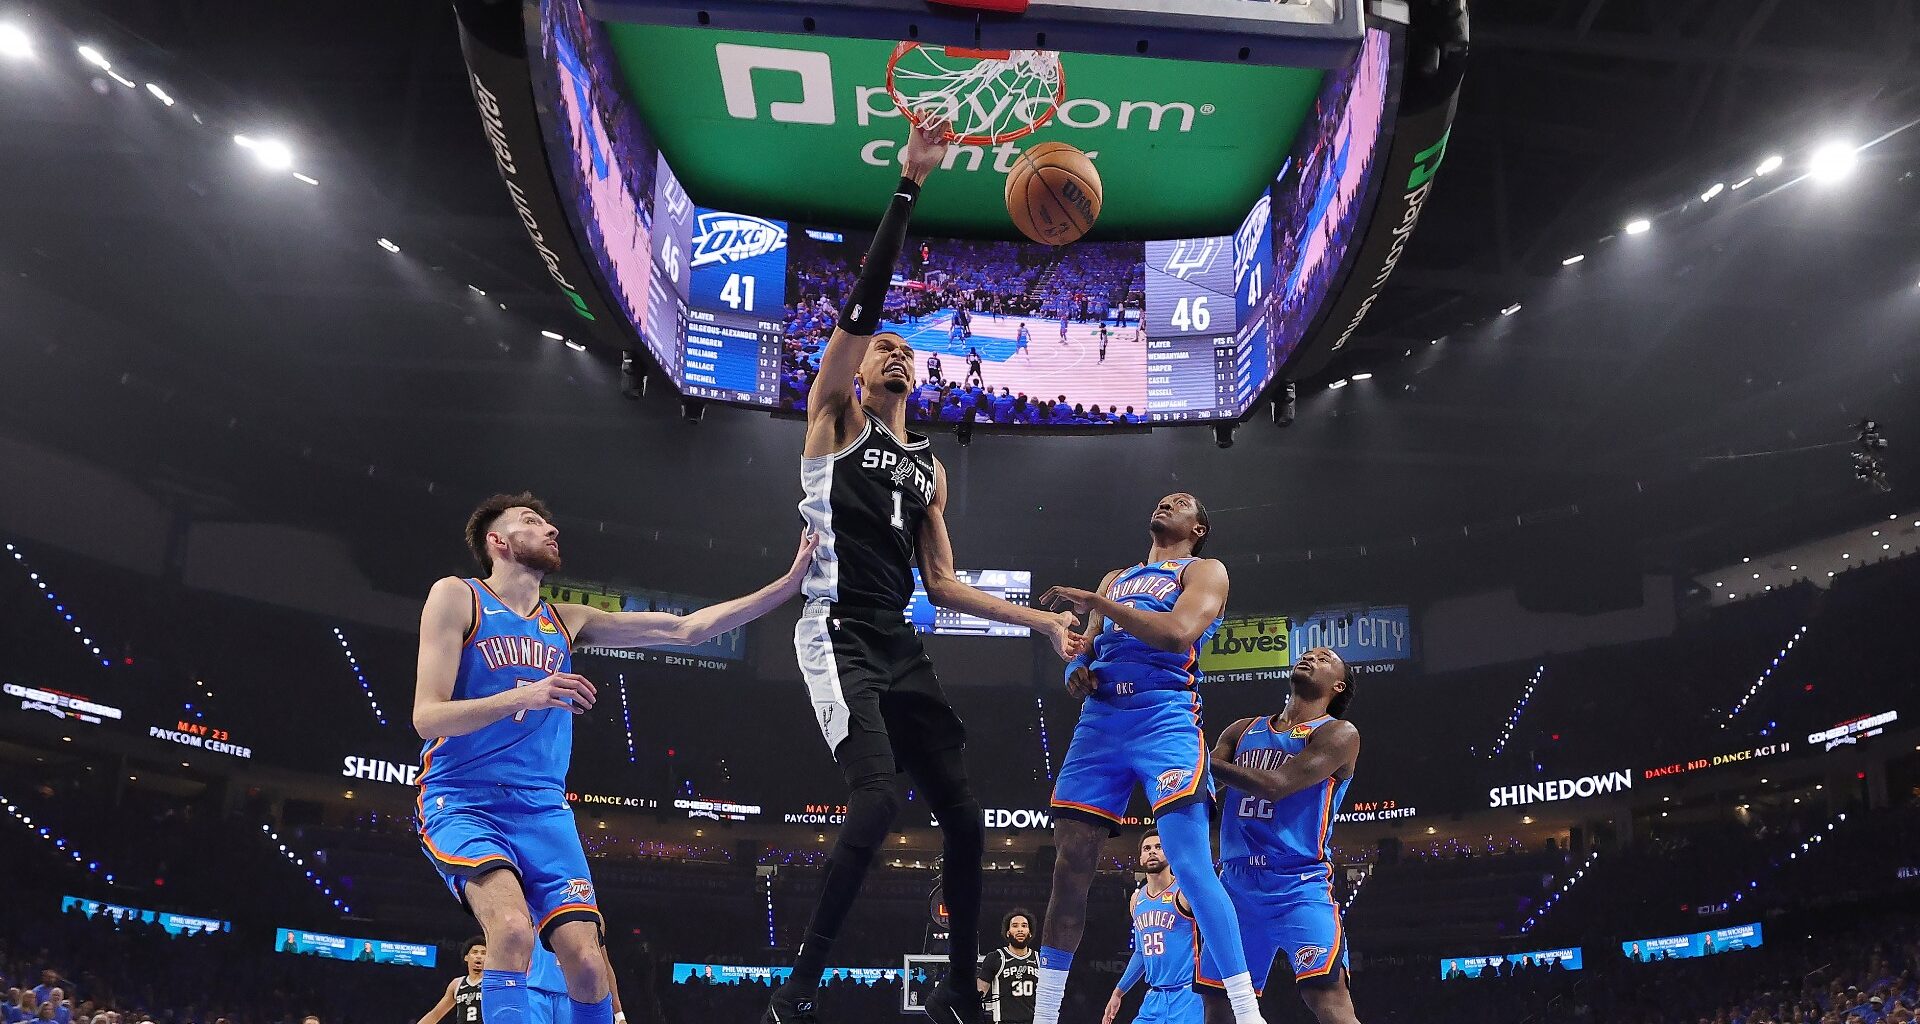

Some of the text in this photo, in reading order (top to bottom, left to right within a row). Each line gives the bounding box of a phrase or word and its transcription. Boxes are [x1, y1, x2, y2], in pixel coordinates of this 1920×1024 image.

[474, 73, 575, 290] paycom center
[1372, 181, 1430, 289] paycom
[661, 233, 680, 284] 46
[719, 272, 755, 312] 41
[1247, 261, 1262, 307] 41
[690, 310, 780, 331] PLAYER PTS FL
[1170, 296, 1211, 332] 46
[688, 322, 758, 340] GILGEOUS-ALEXANDER
[687, 335, 723, 348] HOLMGREN
[1148, 336, 1235, 349] PLAYER PTS FL
[686, 347, 718, 359] WILLIAMS
[760, 358, 769, 367] 12
[1148, 351, 1190, 360] WEMBANYAMA
[1216, 349, 1225, 357] 12
[686, 360, 715, 372] WALLACE
[1148, 364, 1173, 372] HARPER
[685, 372, 717, 384] MITCHELL
[1148, 376, 1170, 384] CASTLE
[737, 392, 751, 401] 2ND
[890, 490, 904, 531] 1
[1295, 618, 1349, 660] LOUD
[1358, 617, 1404, 652] CITY
[476, 635, 565, 674] THUNDER
[583, 646, 728, 671] THUNDER EXIT NOW
[1228, 672, 1253, 682] THE
[1255, 670, 1294, 681] THUN
[1366, 663, 1395, 674] NOW
[1116, 681, 1135, 695] OKC
[177, 720, 229, 741] MAY 23
[149, 726, 252, 759] PAYCOM CENTER
[1645, 764, 1685, 779] DANCE,
[1713, 750, 1752, 766] DANCE
[1754, 744, 1777, 758] ACT
[1489, 768, 1633, 808] SHINEDOWN
[584, 793, 622, 805] DANCE
[623, 797, 645, 807] ACT
[1354, 800, 1395, 812] MAY 23
[805, 804, 848, 814] MAY 23
[1334, 807, 1416, 823] PAYCOM CENTER
[784, 813, 826, 824] PAYCOM
[983, 808, 1055, 829] EDOW
[571, 883, 592, 897] OKC
[1143, 931, 1165, 957] 25
[1658, 937, 1689, 947] WICKHAM
[722, 965, 770, 974] PHIL WICKHAM
[862, 968, 897, 976] WICKAM
[1011, 980, 1034, 997] 30
[466, 1006, 478, 1022] 2
